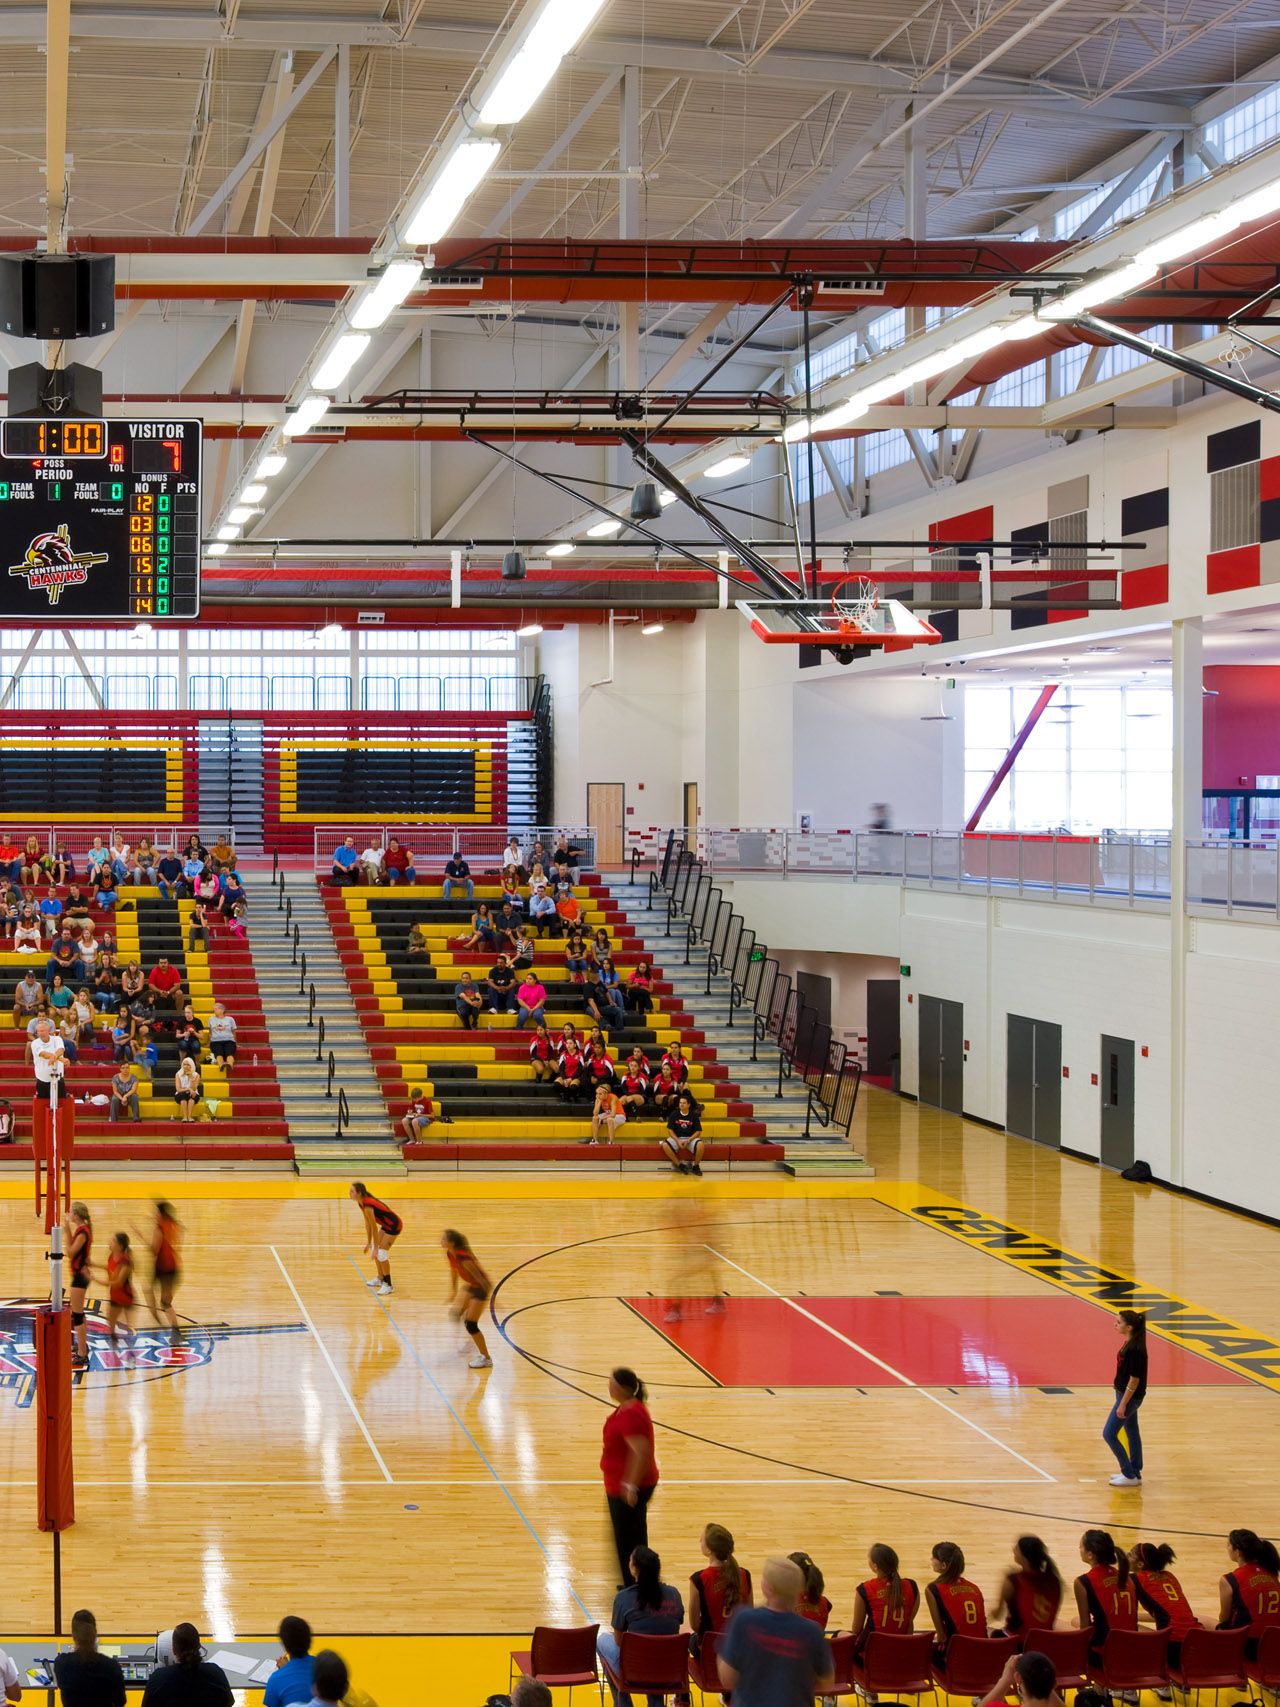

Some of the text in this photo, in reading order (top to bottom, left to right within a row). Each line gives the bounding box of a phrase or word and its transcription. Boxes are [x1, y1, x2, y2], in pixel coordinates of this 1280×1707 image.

[38, 424, 101, 453] 1:00
[129, 424, 184, 438] VISITOR
[112, 446, 122, 462] 0
[163, 442, 179, 471] 7
[44, 460, 64, 468] POSS
[109, 464, 124, 472] TOL
[35, 469, 73, 480] PERIOD
[141, 474, 168, 482] BONUS
[11, 482, 33, 491] TEAM
[55, 484, 60, 498] 1
[75, 482, 97, 491] TEAM
[112, 483, 122, 499] 0
[135, 483, 196, 493] NO F PTS
[10, 491, 35, 499] FOULS
[74, 491, 99, 499] FOULS
[137, 496, 168, 511] 12 0
[131, 516, 168, 532] 03 0
[131, 537, 168, 553] 06 0
[29, 562, 84, 575] CENTENNIAL
[137, 557, 168, 573] 15 2
[30, 569, 86, 587] HAWKS
[136, 578, 168, 593] 11 0
[136, 598, 167, 613] 14 0
[911, 1206, 1280, 1379] CENTENNIAL
[1162, 1583, 1179, 1601] 9
[1113, 1591, 1132, 1615] 17
[1258, 1590, 1280, 1615] 12
[881, 1604, 905, 1629] 14
[964, 1600, 977, 1624] 8
